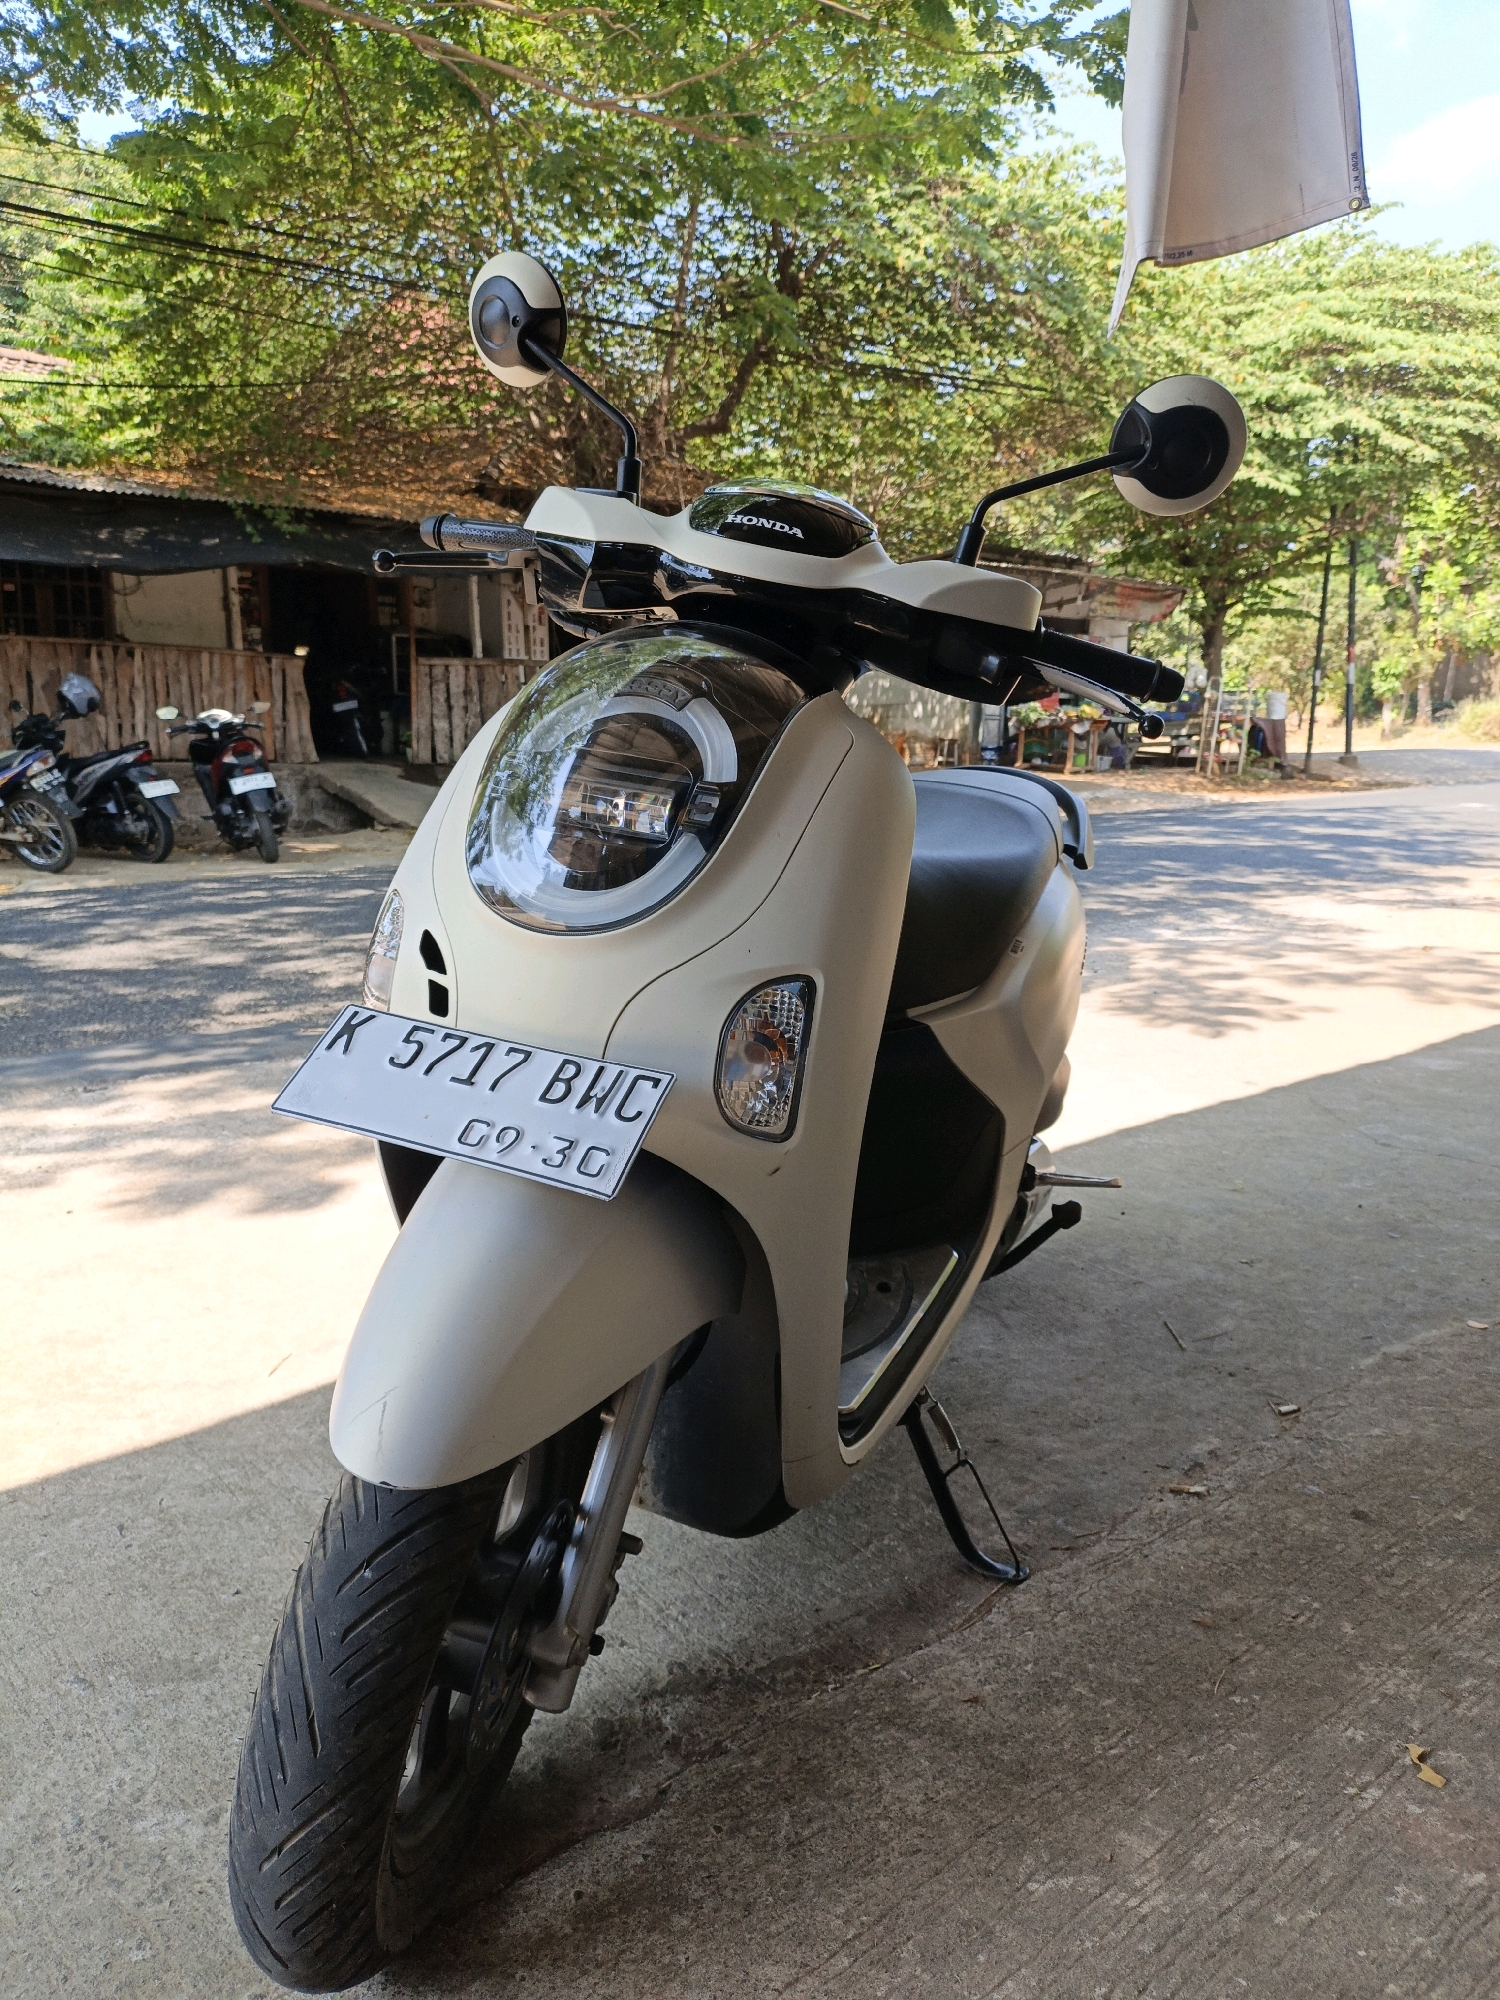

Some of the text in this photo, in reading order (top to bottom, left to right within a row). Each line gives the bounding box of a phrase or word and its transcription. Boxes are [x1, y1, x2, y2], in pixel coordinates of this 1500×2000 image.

[725, 514, 804, 539] HONDA
[325, 1010, 662, 1123] K 5717 BWC
